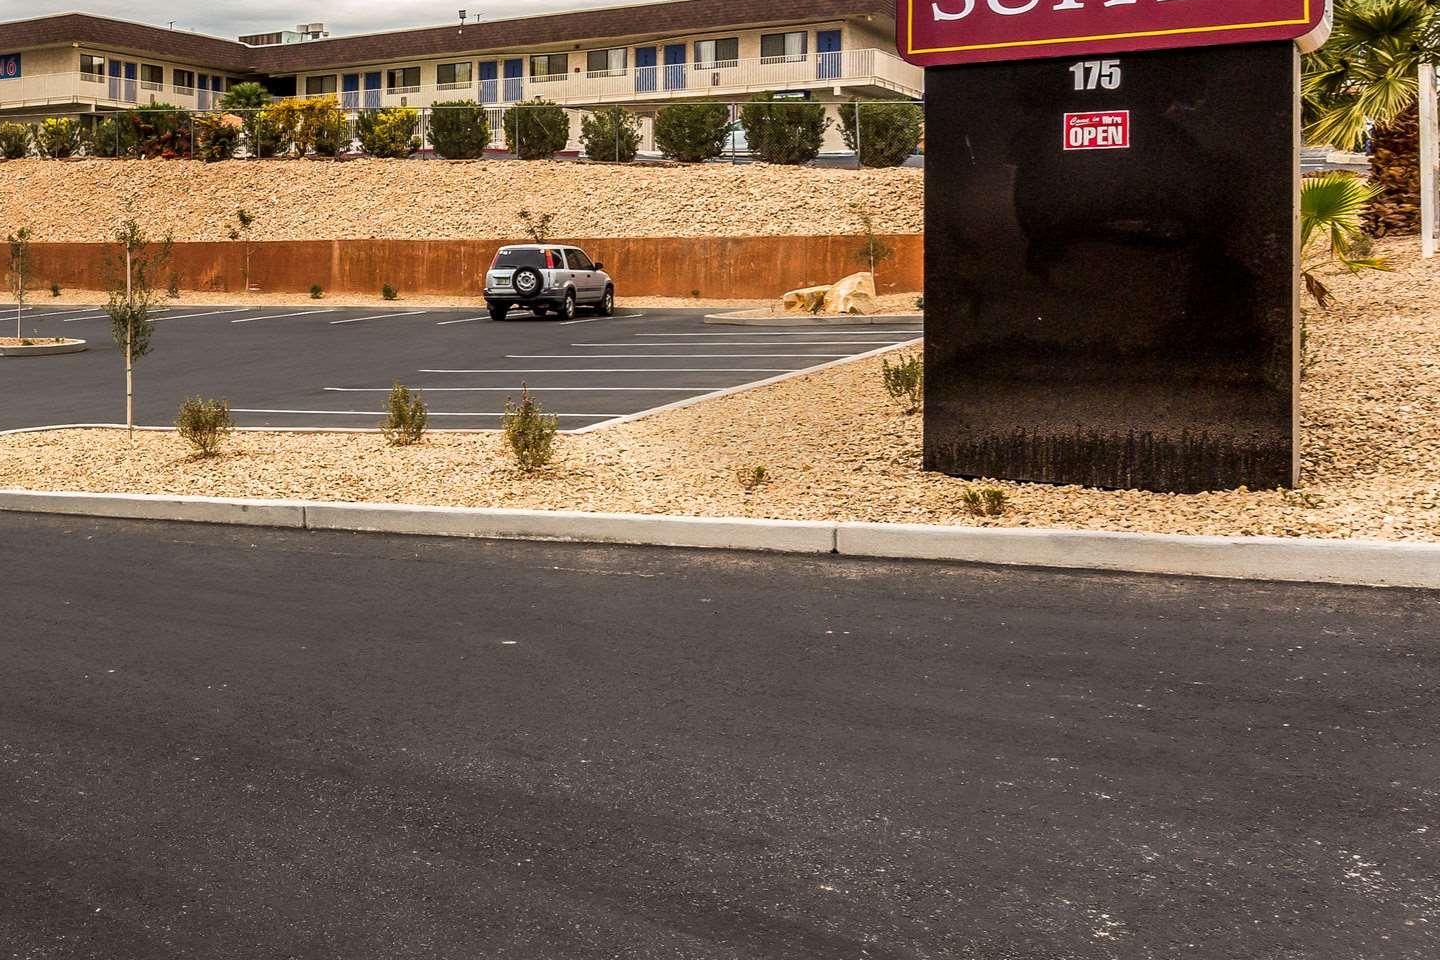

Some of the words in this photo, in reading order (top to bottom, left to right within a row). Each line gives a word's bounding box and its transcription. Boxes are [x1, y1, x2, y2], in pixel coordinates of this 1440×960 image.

[6, 58, 17, 76] 6
[1069, 60, 1121, 90] 175
[1069, 126, 1123, 147] OPEN
